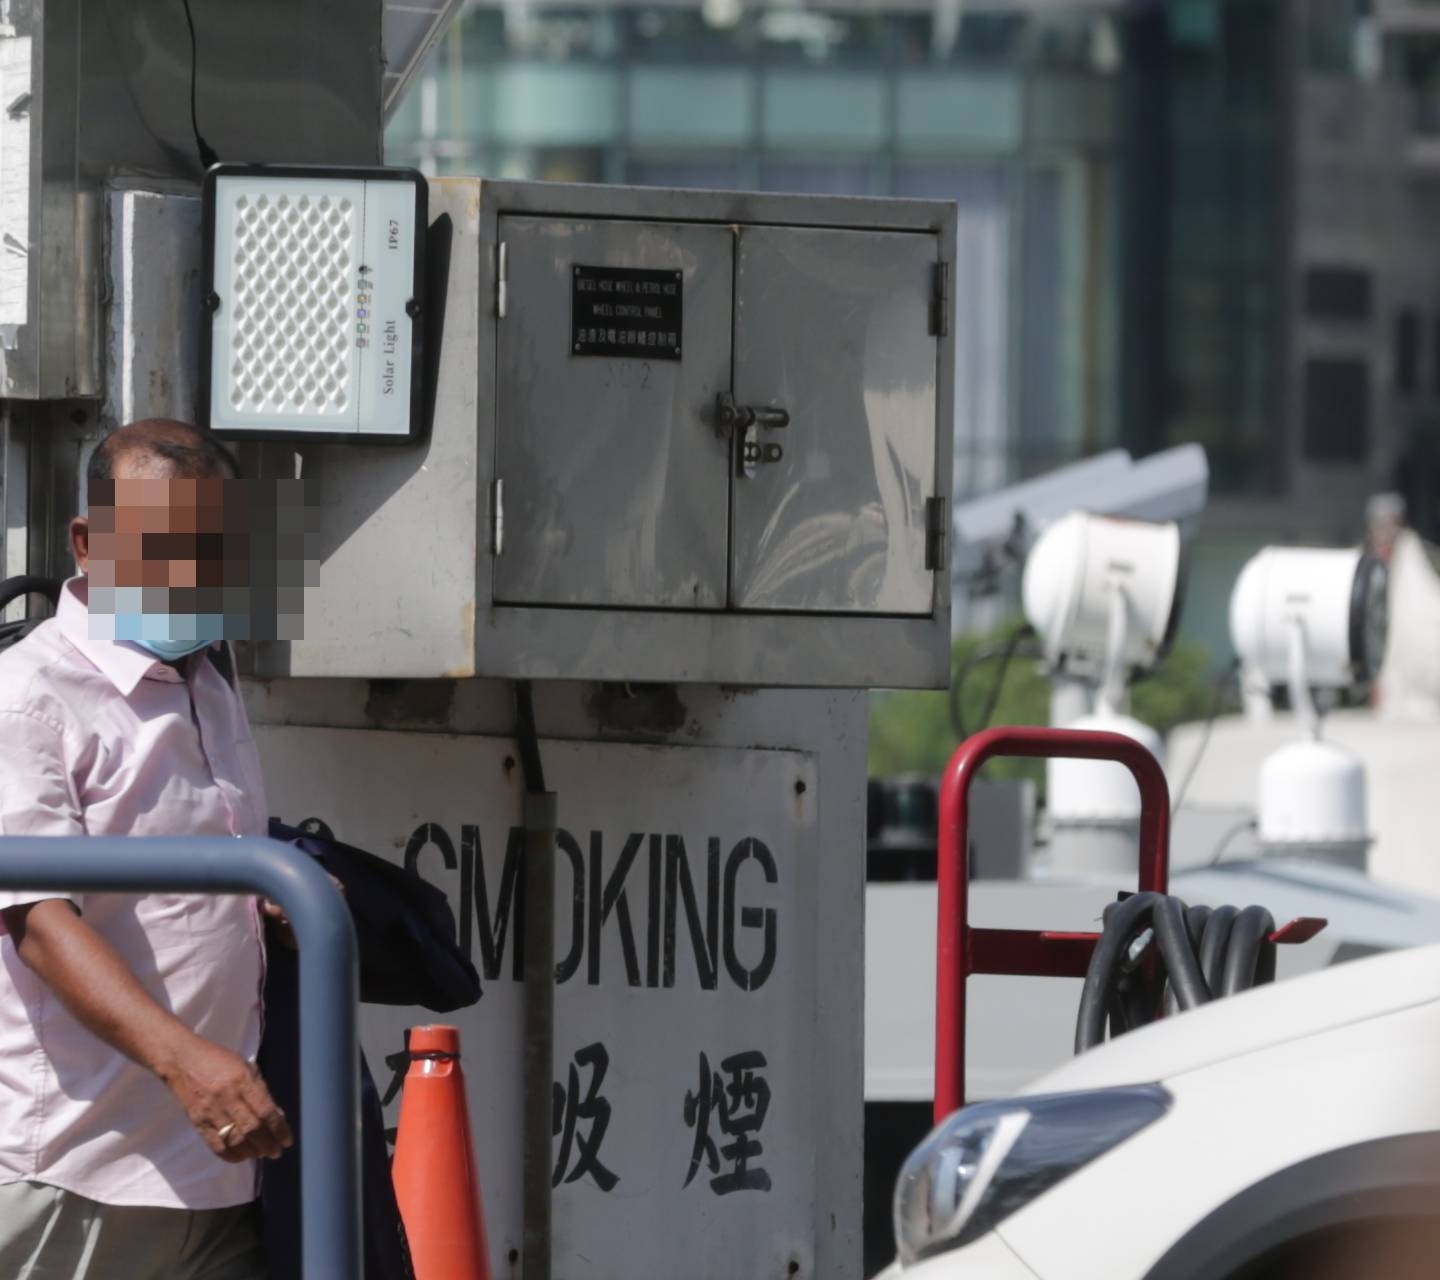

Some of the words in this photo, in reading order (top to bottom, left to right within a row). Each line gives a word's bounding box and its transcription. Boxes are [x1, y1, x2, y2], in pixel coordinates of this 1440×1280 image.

[389, 219, 399, 250] IP67
[384, 320, 398, 355] Light
[383, 360, 395, 395] Solar
